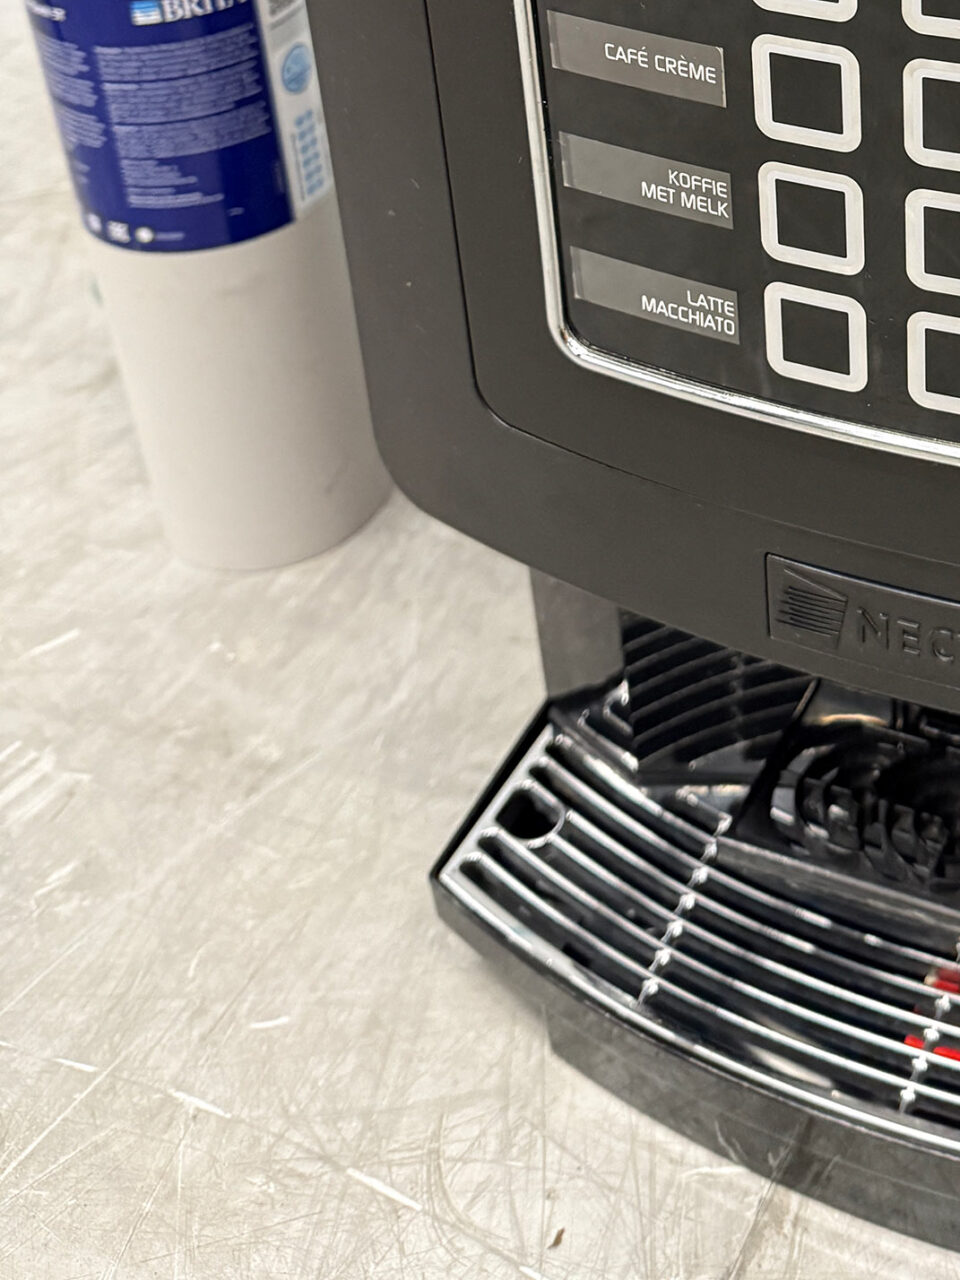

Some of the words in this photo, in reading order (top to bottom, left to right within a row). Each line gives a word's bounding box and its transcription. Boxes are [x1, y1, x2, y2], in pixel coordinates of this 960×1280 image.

[603, 42, 649, 68] CAFÉ
[654, 54, 717, 83] CRÈME
[640, 181, 677, 204] MET
[680, 191, 729, 218] MELK
[668, 168, 728, 199] KOFFIE
[640, 294, 736, 336] MACCHIATO
[686, 289, 736, 318] LATTE
